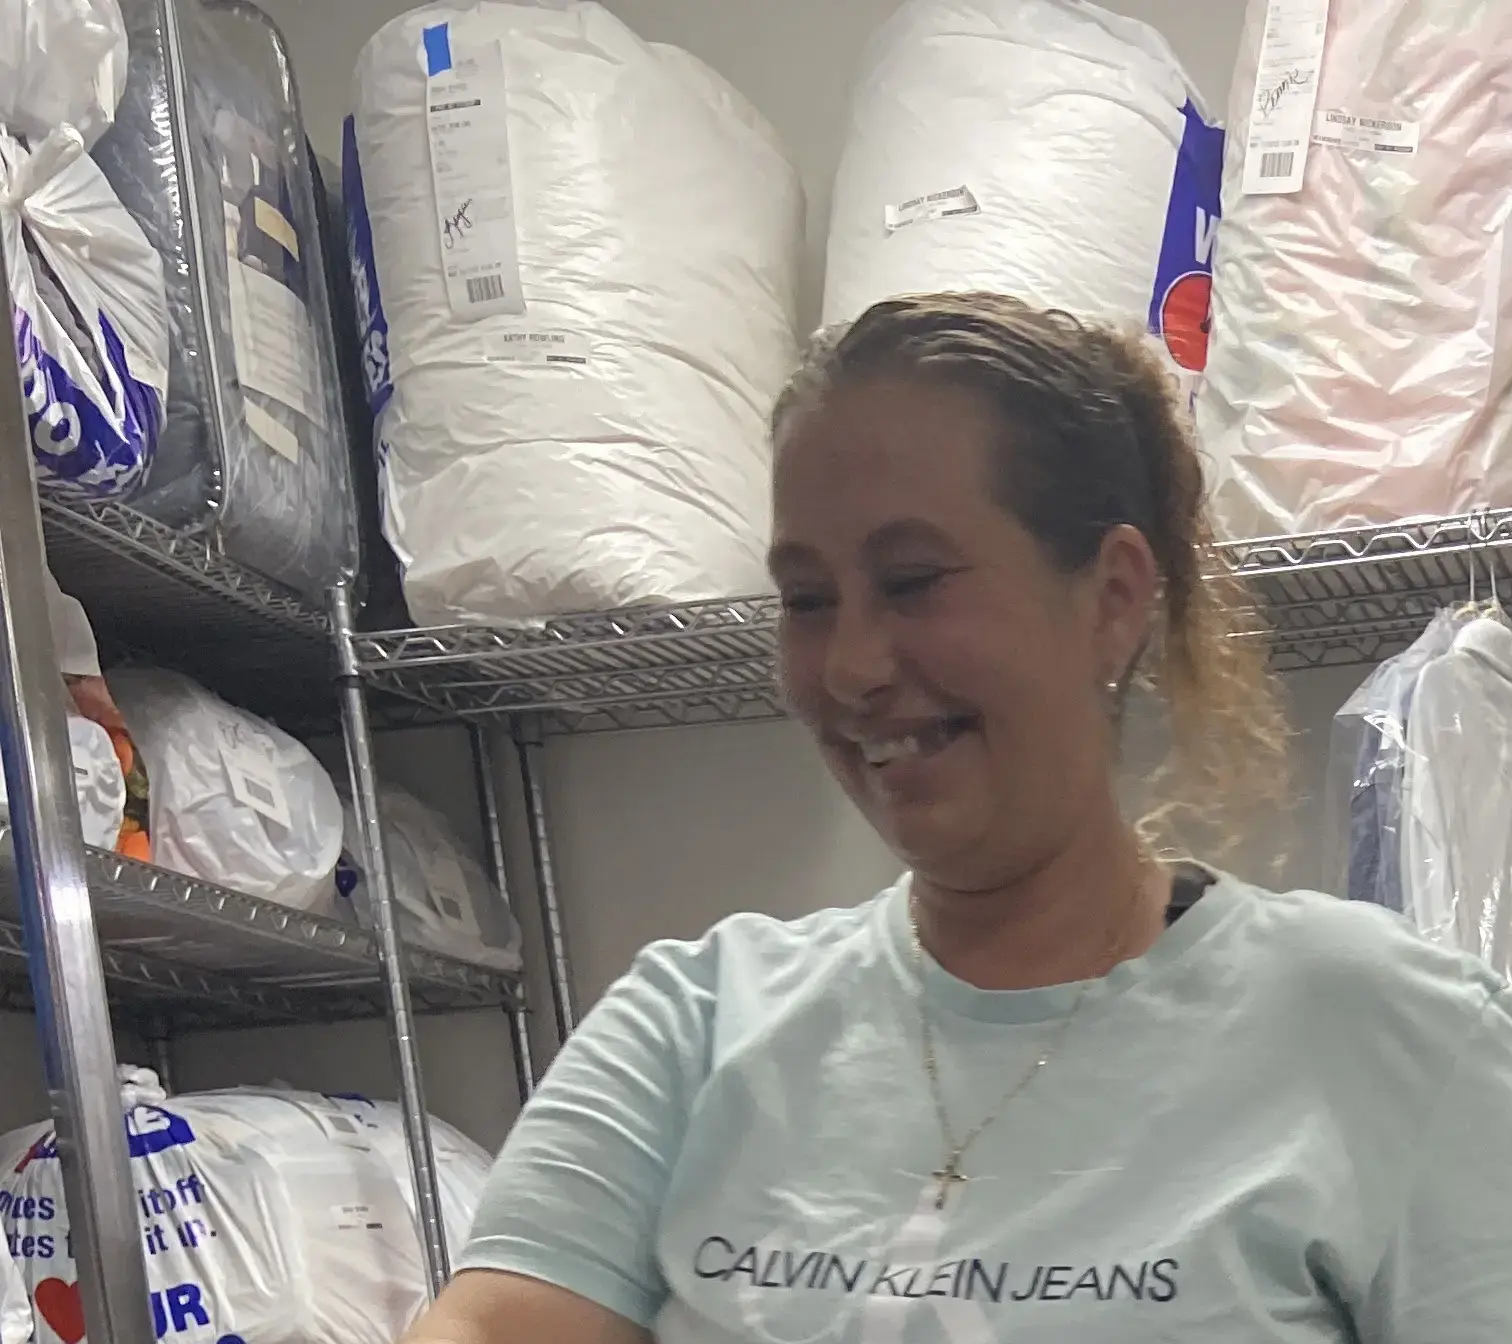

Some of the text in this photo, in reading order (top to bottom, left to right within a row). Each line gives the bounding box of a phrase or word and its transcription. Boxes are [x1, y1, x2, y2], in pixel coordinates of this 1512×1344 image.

[693, 1235, 1180, 1303] CALVIN KLEIN JEANS
